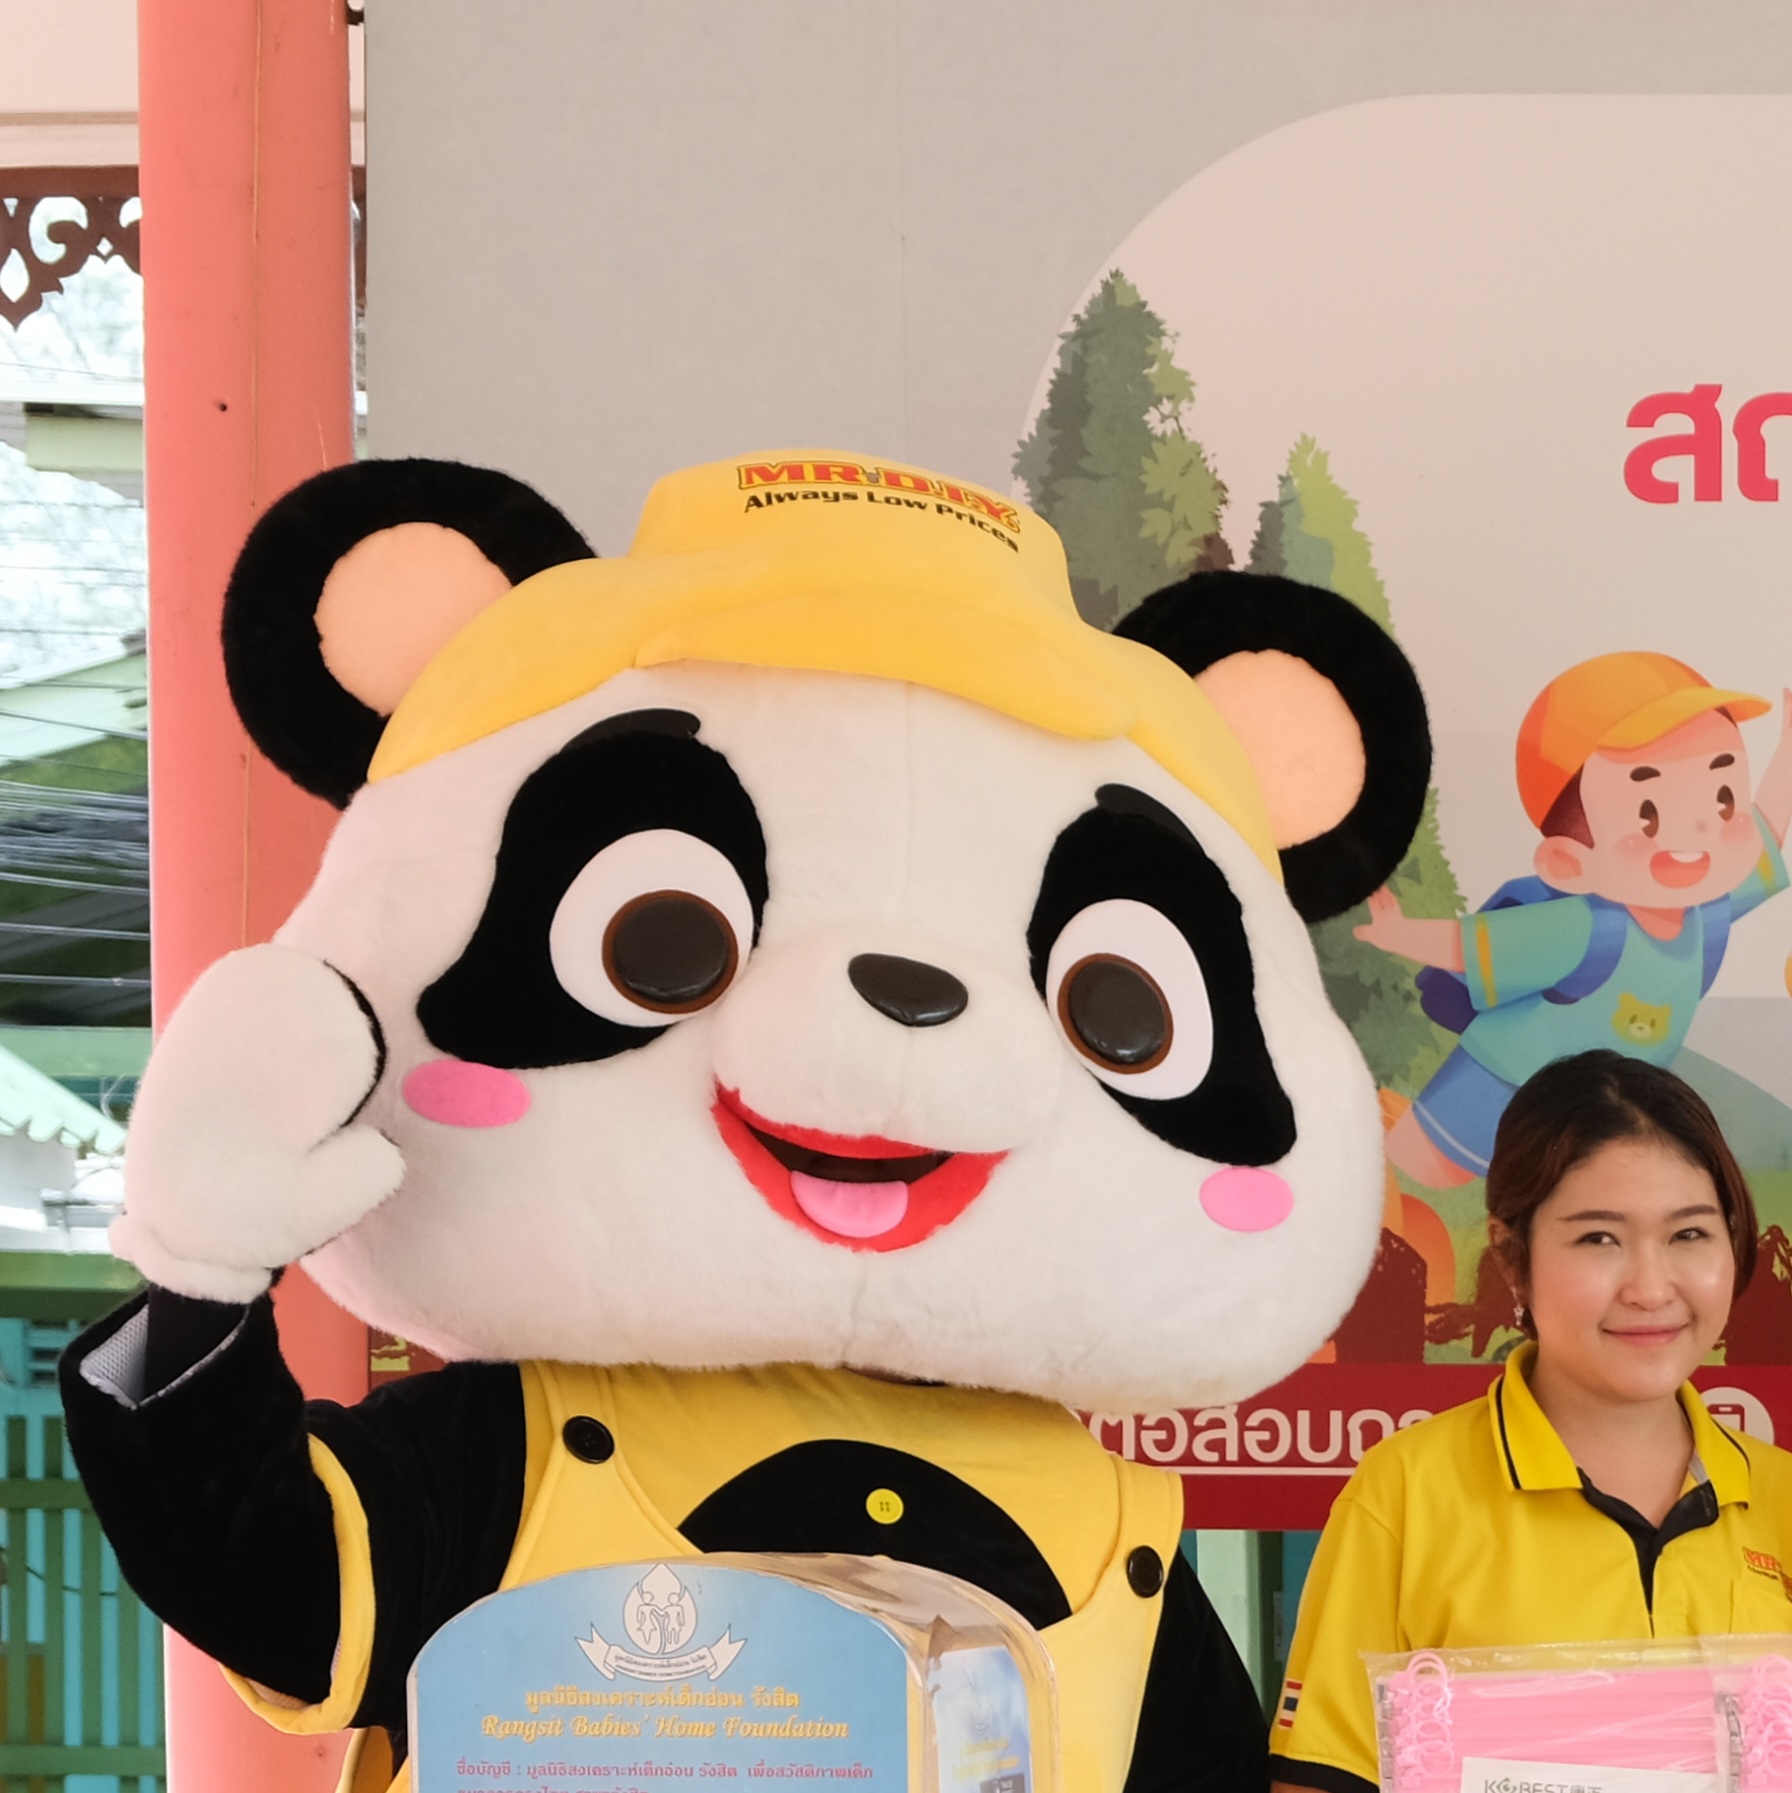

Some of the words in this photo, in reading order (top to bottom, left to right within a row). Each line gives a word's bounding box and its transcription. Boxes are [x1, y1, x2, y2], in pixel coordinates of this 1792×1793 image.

[744, 488, 858, 513] Always
[867, 491, 927, 511] Low
[936, 503, 1019, 553] Prices
[752, 1687, 800, 1708] รังสิต
[481, 1716, 565, 1742] Rangsit
[656, 1717, 716, 1738] Home
[724, 1717, 849, 1739] Foundation
[699, 1764, 737, 1778] รังสิต
